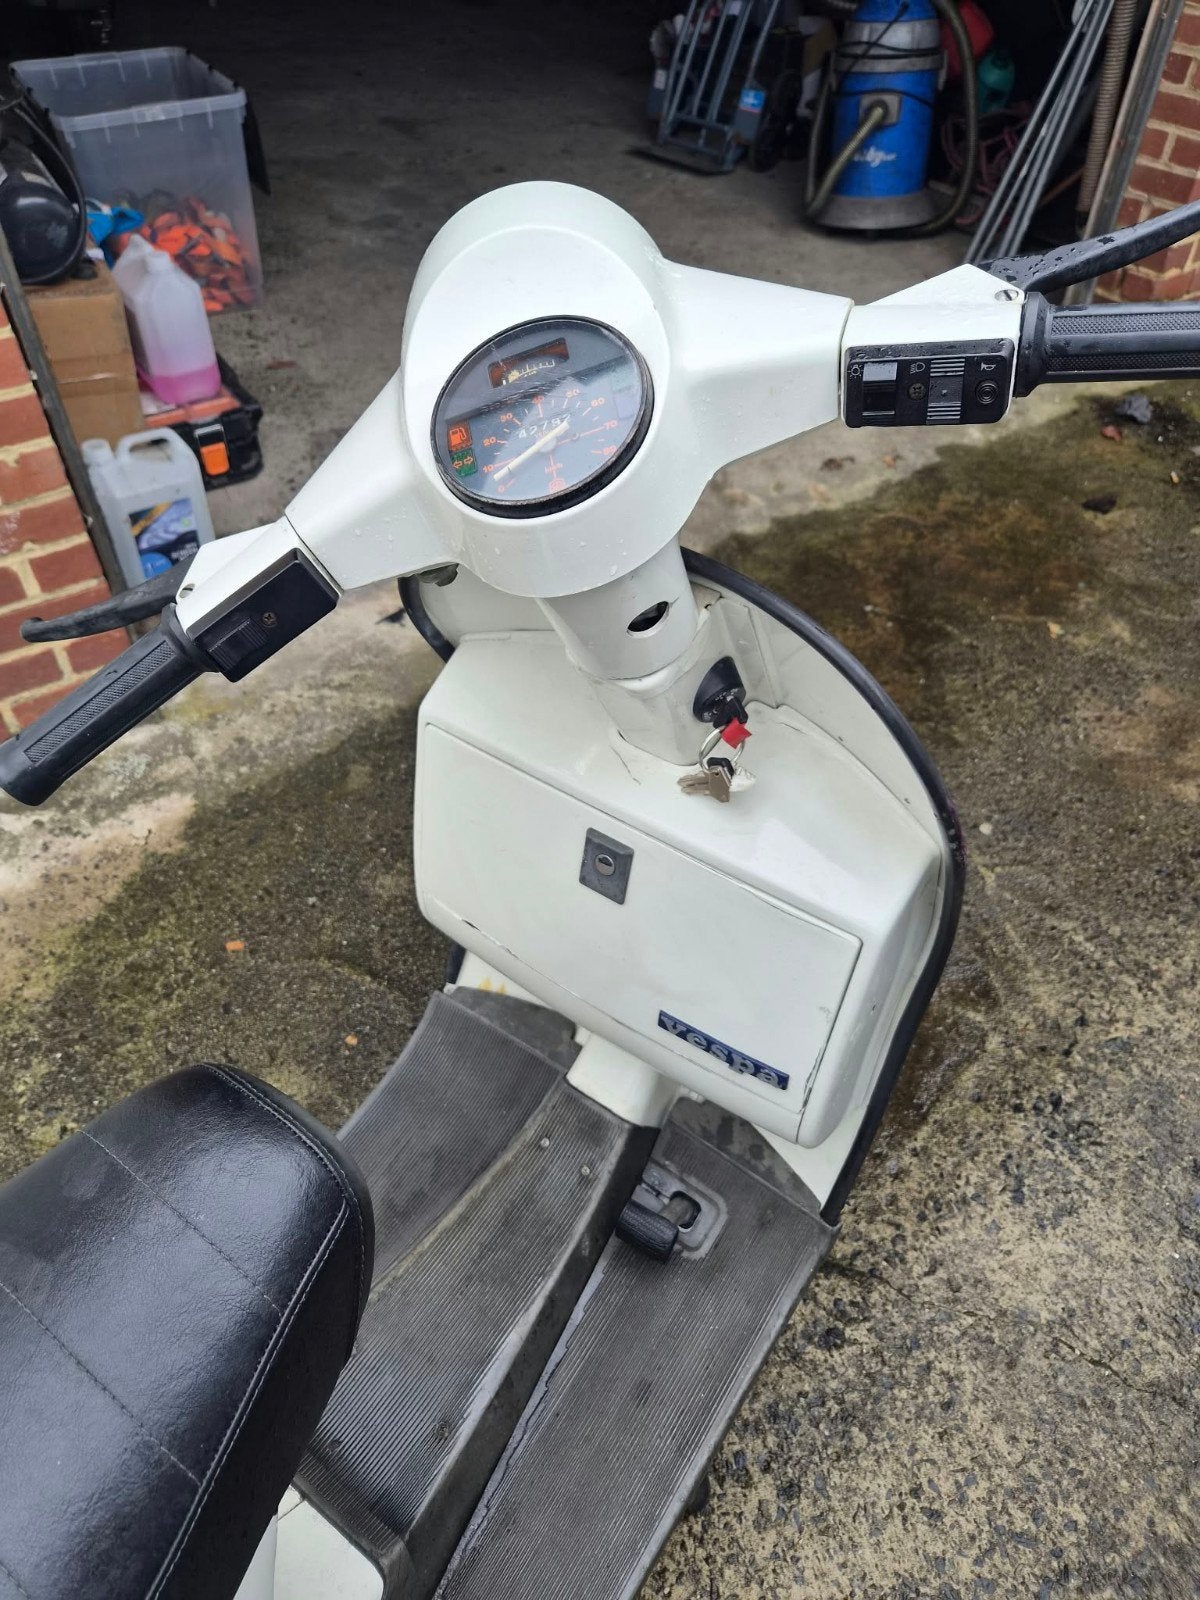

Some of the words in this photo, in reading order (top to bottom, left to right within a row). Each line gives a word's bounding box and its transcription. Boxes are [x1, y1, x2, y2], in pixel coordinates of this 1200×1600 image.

[604, 420, 618, 429] 70
[483, 436, 497, 446] 20
[482, 464, 495, 473] 10
[661, 1015, 783, 1089] vespa
